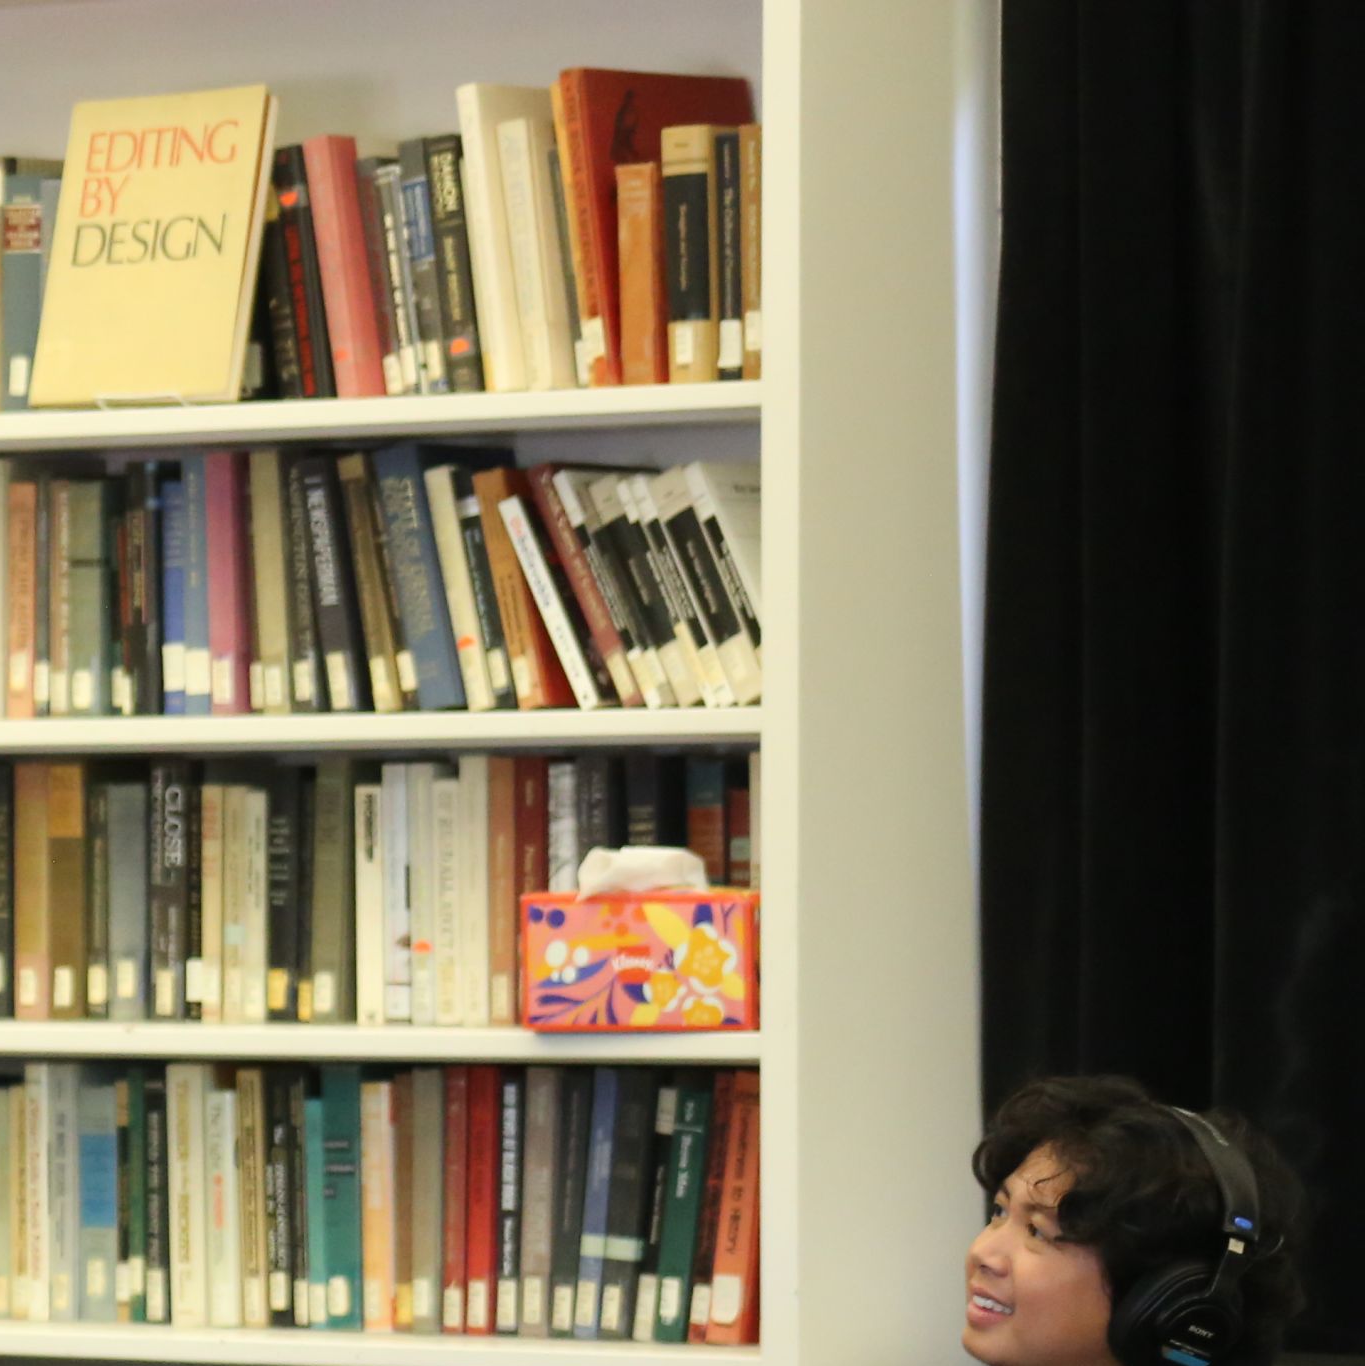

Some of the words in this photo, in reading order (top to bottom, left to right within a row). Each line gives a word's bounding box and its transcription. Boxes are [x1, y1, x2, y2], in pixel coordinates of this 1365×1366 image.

[85, 119, 240, 174] EDITING
[79, 175, 130, 220] BY
[70, 214, 228, 268] DESIGN
[306, 489, 340, 606] NEWSPAPERMAN
[164, 785, 184, 867] CLOSE
[1188, 1325, 1214, 1338] SONY
